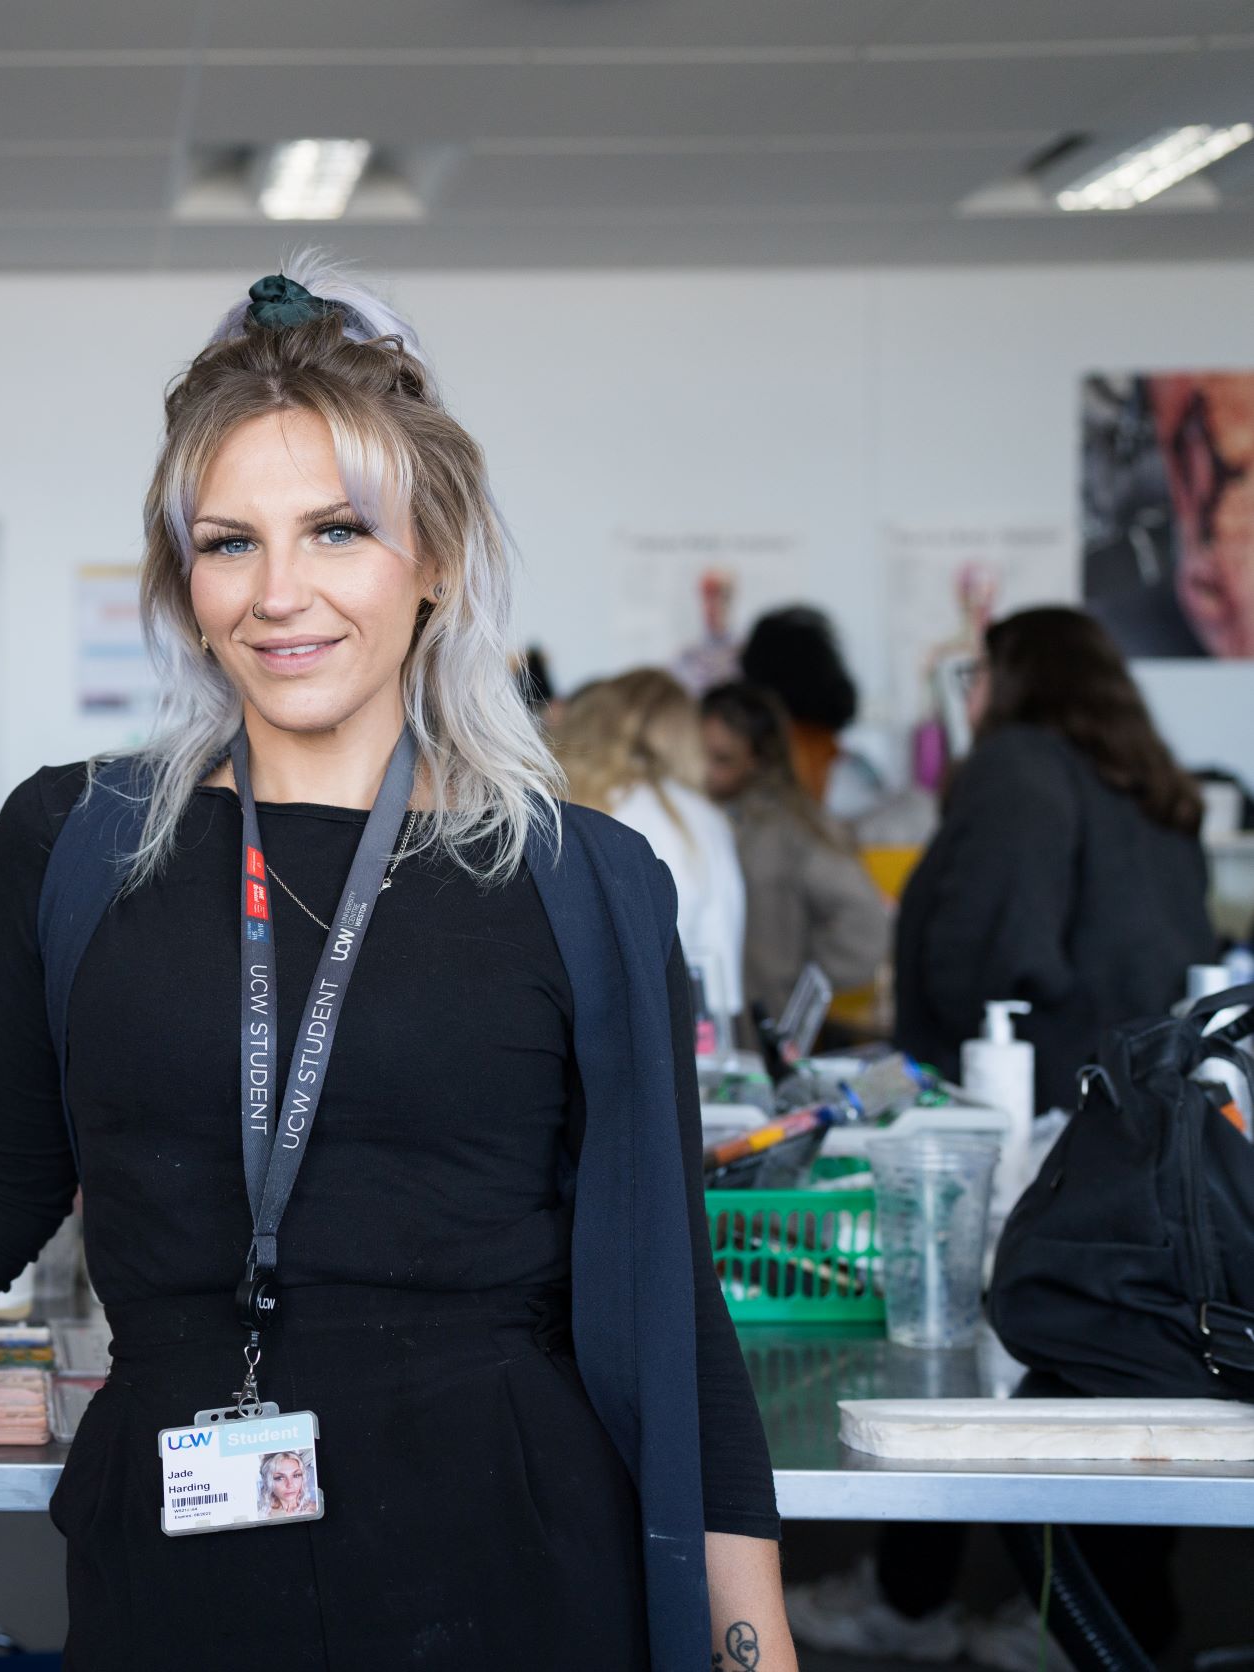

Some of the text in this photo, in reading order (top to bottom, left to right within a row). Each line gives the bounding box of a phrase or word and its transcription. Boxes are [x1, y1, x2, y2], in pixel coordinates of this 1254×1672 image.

[342, 890, 357, 925] UNIVERSITY
[348, 902, 361, 927] CENTRE
[354, 902, 368, 927] WESTON
[330, 927, 356, 962] UCW
[250, 965, 268, 1136] UCW STUDENT
[282, 978, 339, 1150] UCW STUDENT
[168, 1431, 212, 1451] UCW
[227, 1424, 299, 1447] Student
[167, 1469, 193, 1480] Jade
[168, 1482, 210, 1495] Harding
